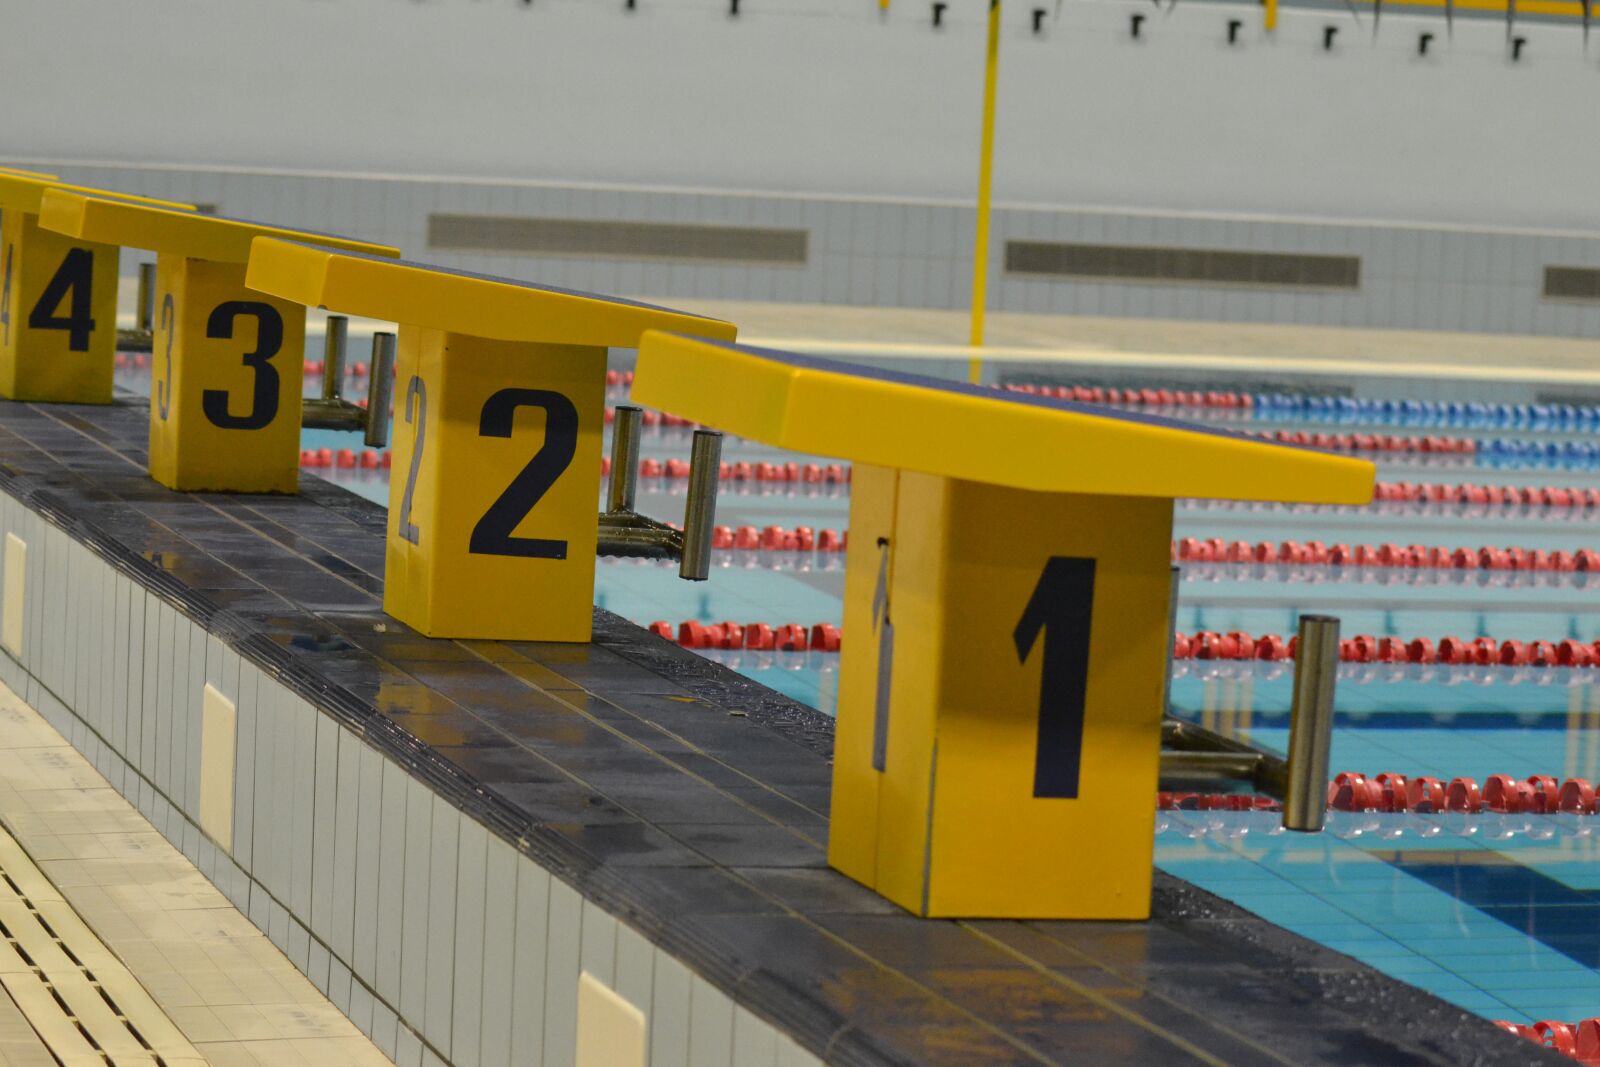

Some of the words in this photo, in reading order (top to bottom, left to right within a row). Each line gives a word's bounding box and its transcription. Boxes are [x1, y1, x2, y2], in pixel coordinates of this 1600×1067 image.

[1, 243, 13, 346] 4
[29, 247, 95, 351] 4
[158, 293, 174, 421] 3
[202, 301, 283, 430] 3
[398, 375, 427, 546] 2
[469, 387, 579, 560] 2
[872, 538, 894, 774] 1
[1013, 556, 1097, 799] 1
